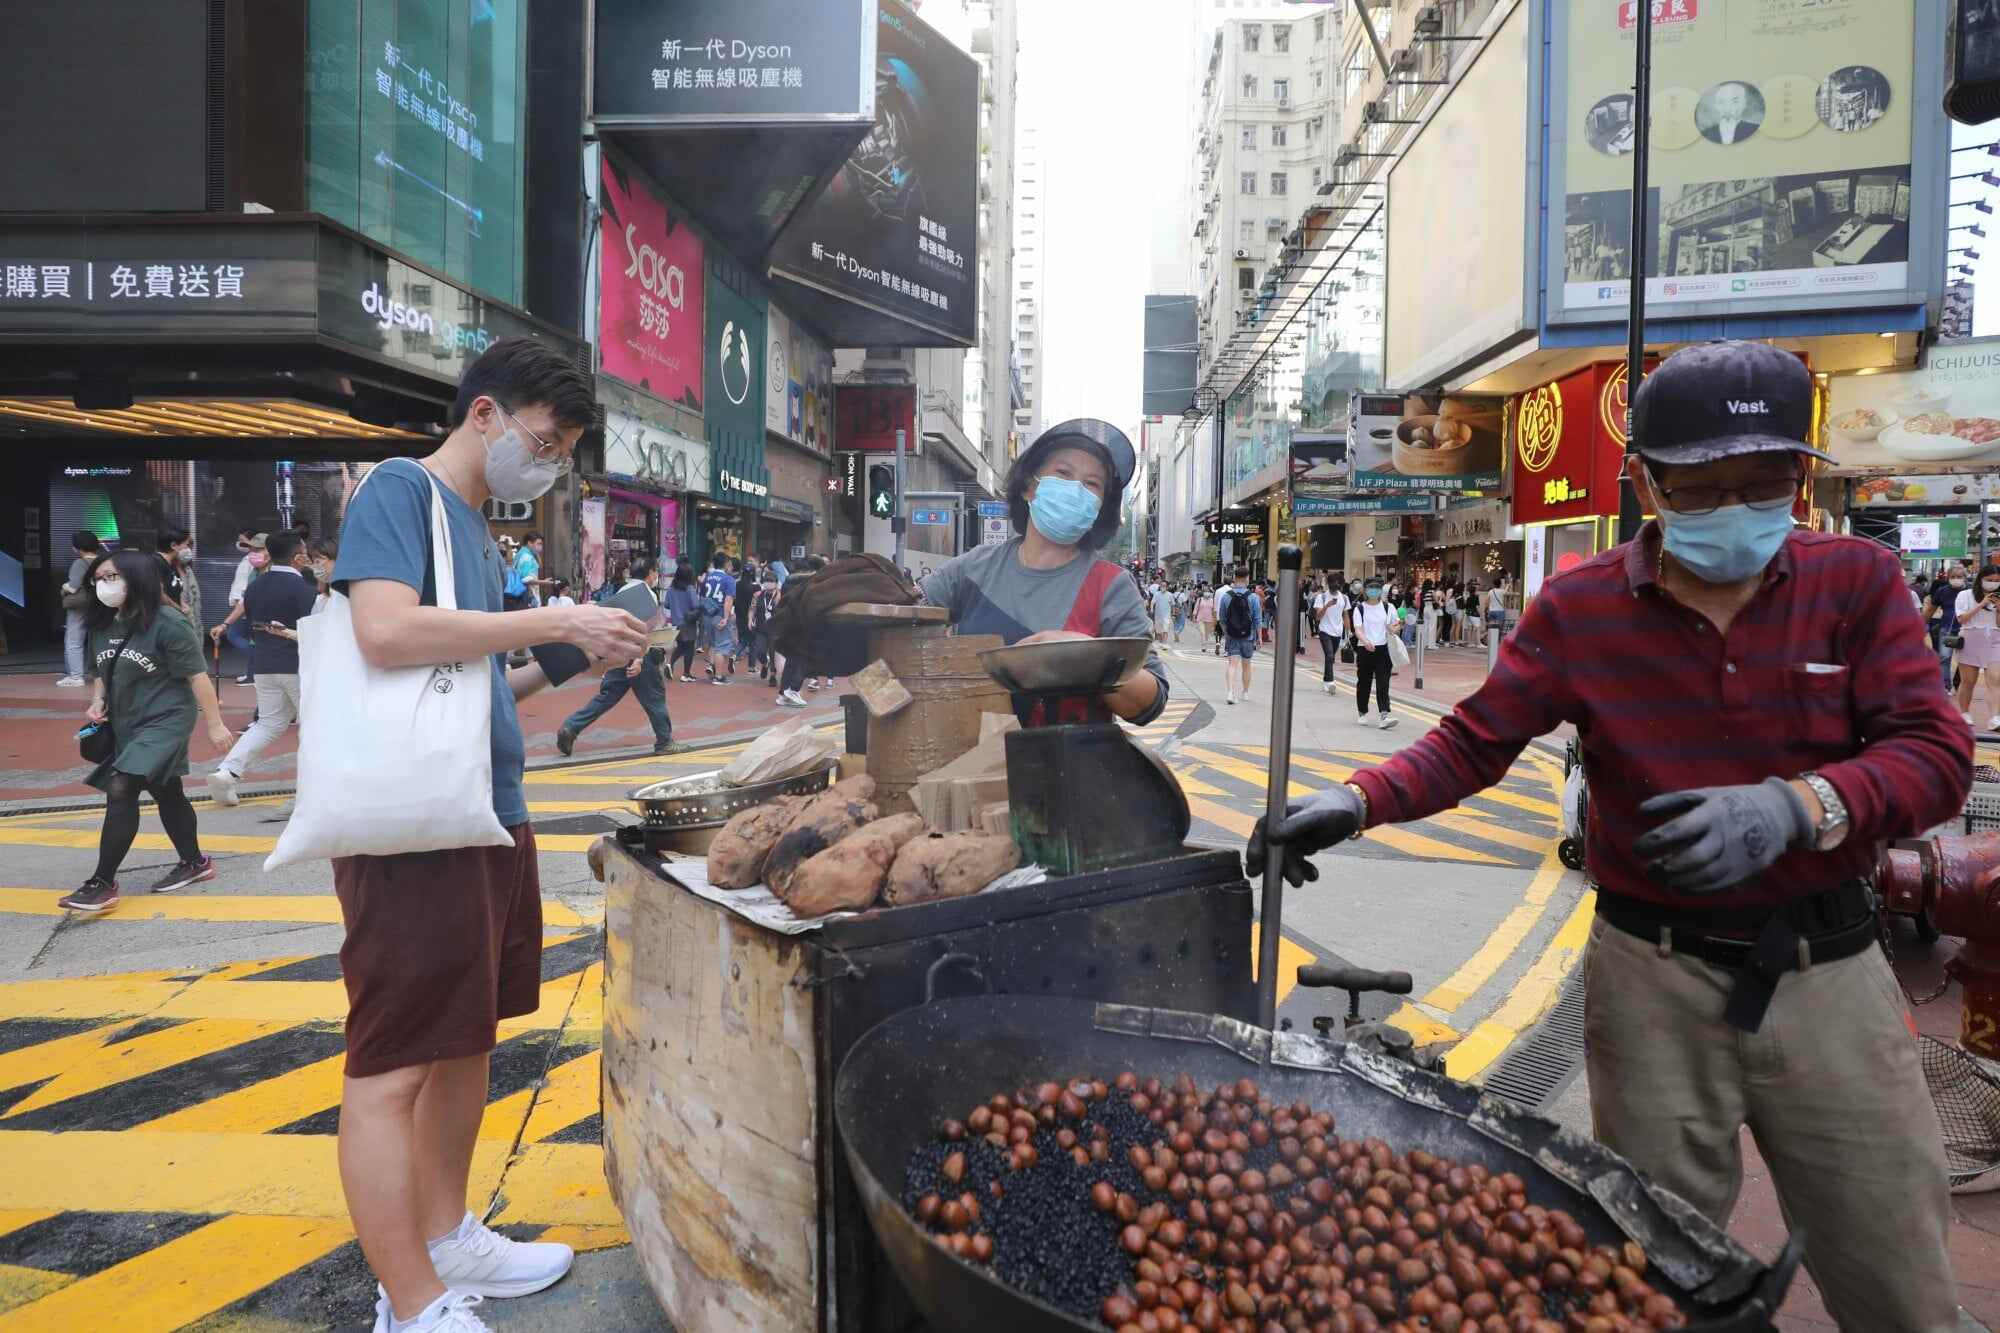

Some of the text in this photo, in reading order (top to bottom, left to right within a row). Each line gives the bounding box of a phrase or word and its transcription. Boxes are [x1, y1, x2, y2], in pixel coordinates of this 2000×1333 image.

[661, 38, 792, 62] 新一代 Dyson
[651, 67, 803, 89] 智能無線吸塵機
[437, 80, 478, 128] Dyson
[811, 241, 847, 271] 新一代
[849, 256, 880, 283] Dyson
[0, 264, 244, 299] 購買 免費送貨
[361, 282, 434, 336] dyson
[640, 293, 670, 340] 莎莎
[1726, 399, 1769, 415] Vast.
[730, 475, 767, 497] THE BODY SHOP
[847, 475, 855, 497] WALK
[1360, 478, 1373, 488] 1/F
[1374, 479, 1384, 488] JP
[1386, 478, 1407, 488] Plaza
